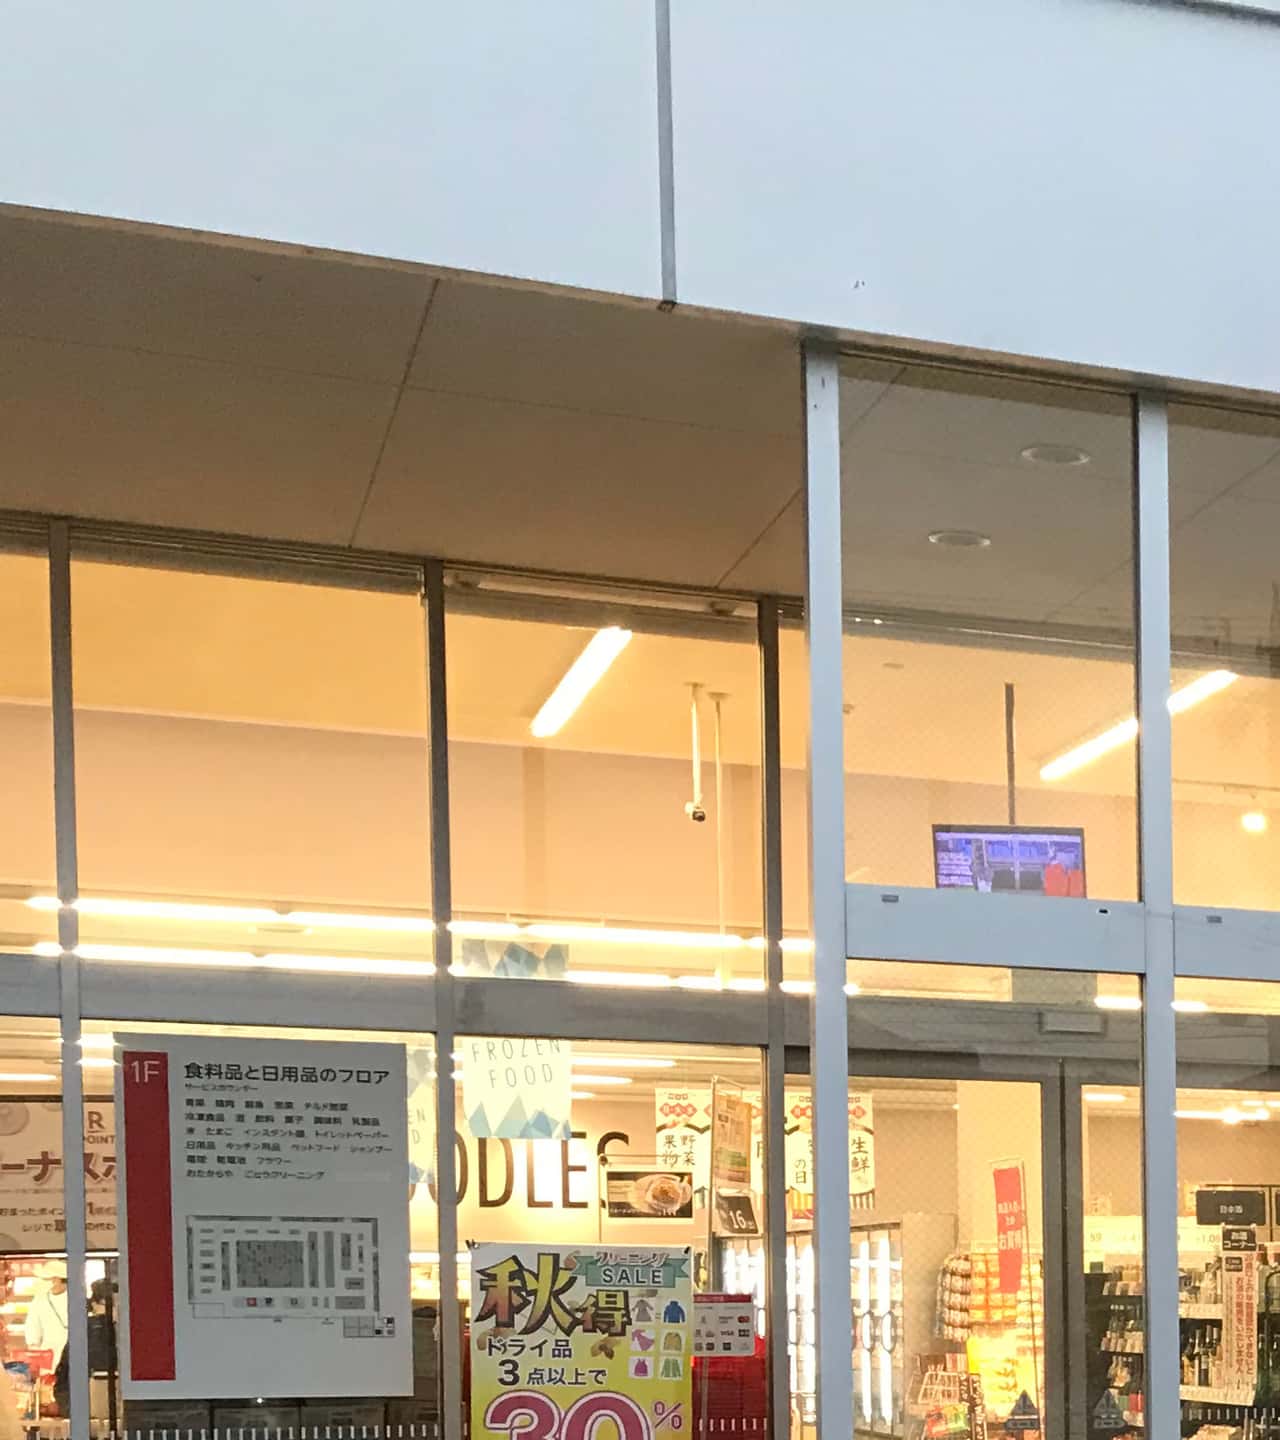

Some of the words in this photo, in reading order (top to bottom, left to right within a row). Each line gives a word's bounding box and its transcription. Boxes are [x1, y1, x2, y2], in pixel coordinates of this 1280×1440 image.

[471, 1039, 562, 1063] FROZEN
[129, 1060, 161, 1085] 1F
[184, 1062, 390, 1085] 食料品と日用品のフロア
[488, 1063, 554, 1089] FOOD
[602, 1268, 663, 1285] SALE
[487, 1339, 572, 1359] ドライ品
